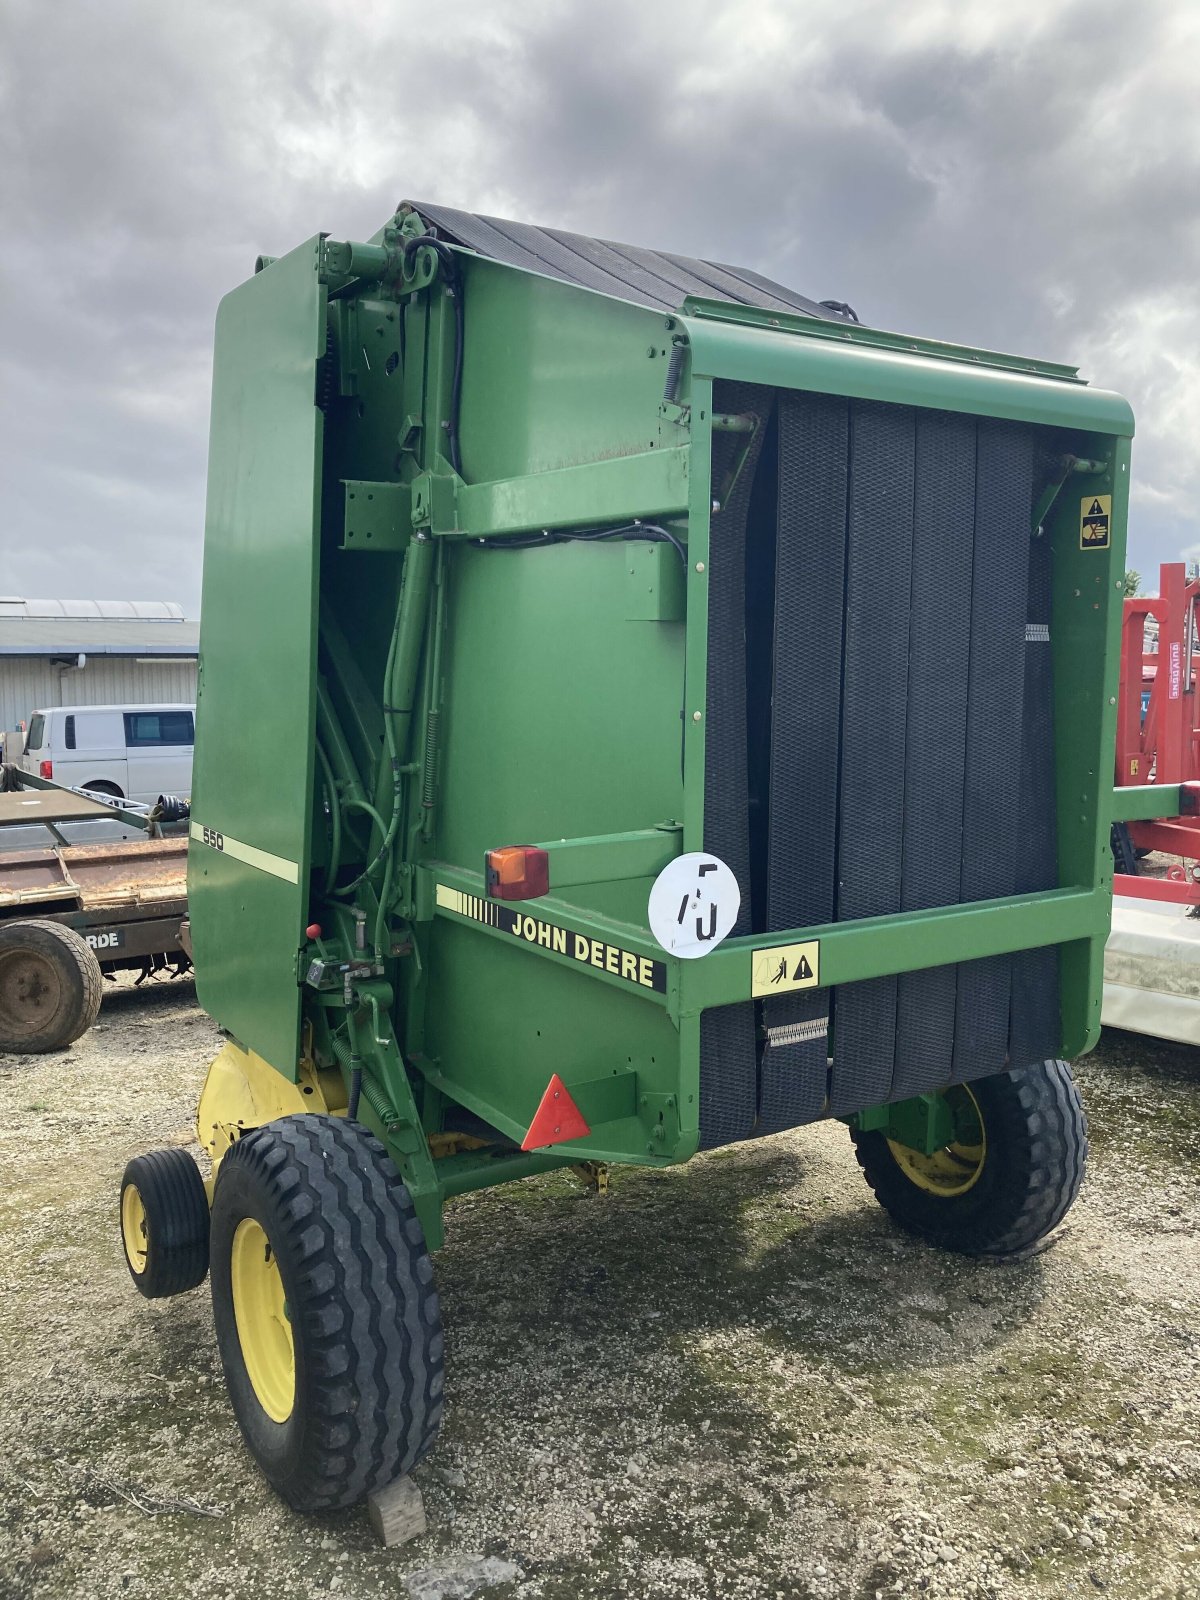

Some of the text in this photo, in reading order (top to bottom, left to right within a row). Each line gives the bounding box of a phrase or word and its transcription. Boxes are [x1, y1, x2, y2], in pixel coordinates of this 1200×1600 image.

[203, 826, 224, 851] 550
[511, 913, 654, 988] JOHN DEERE
